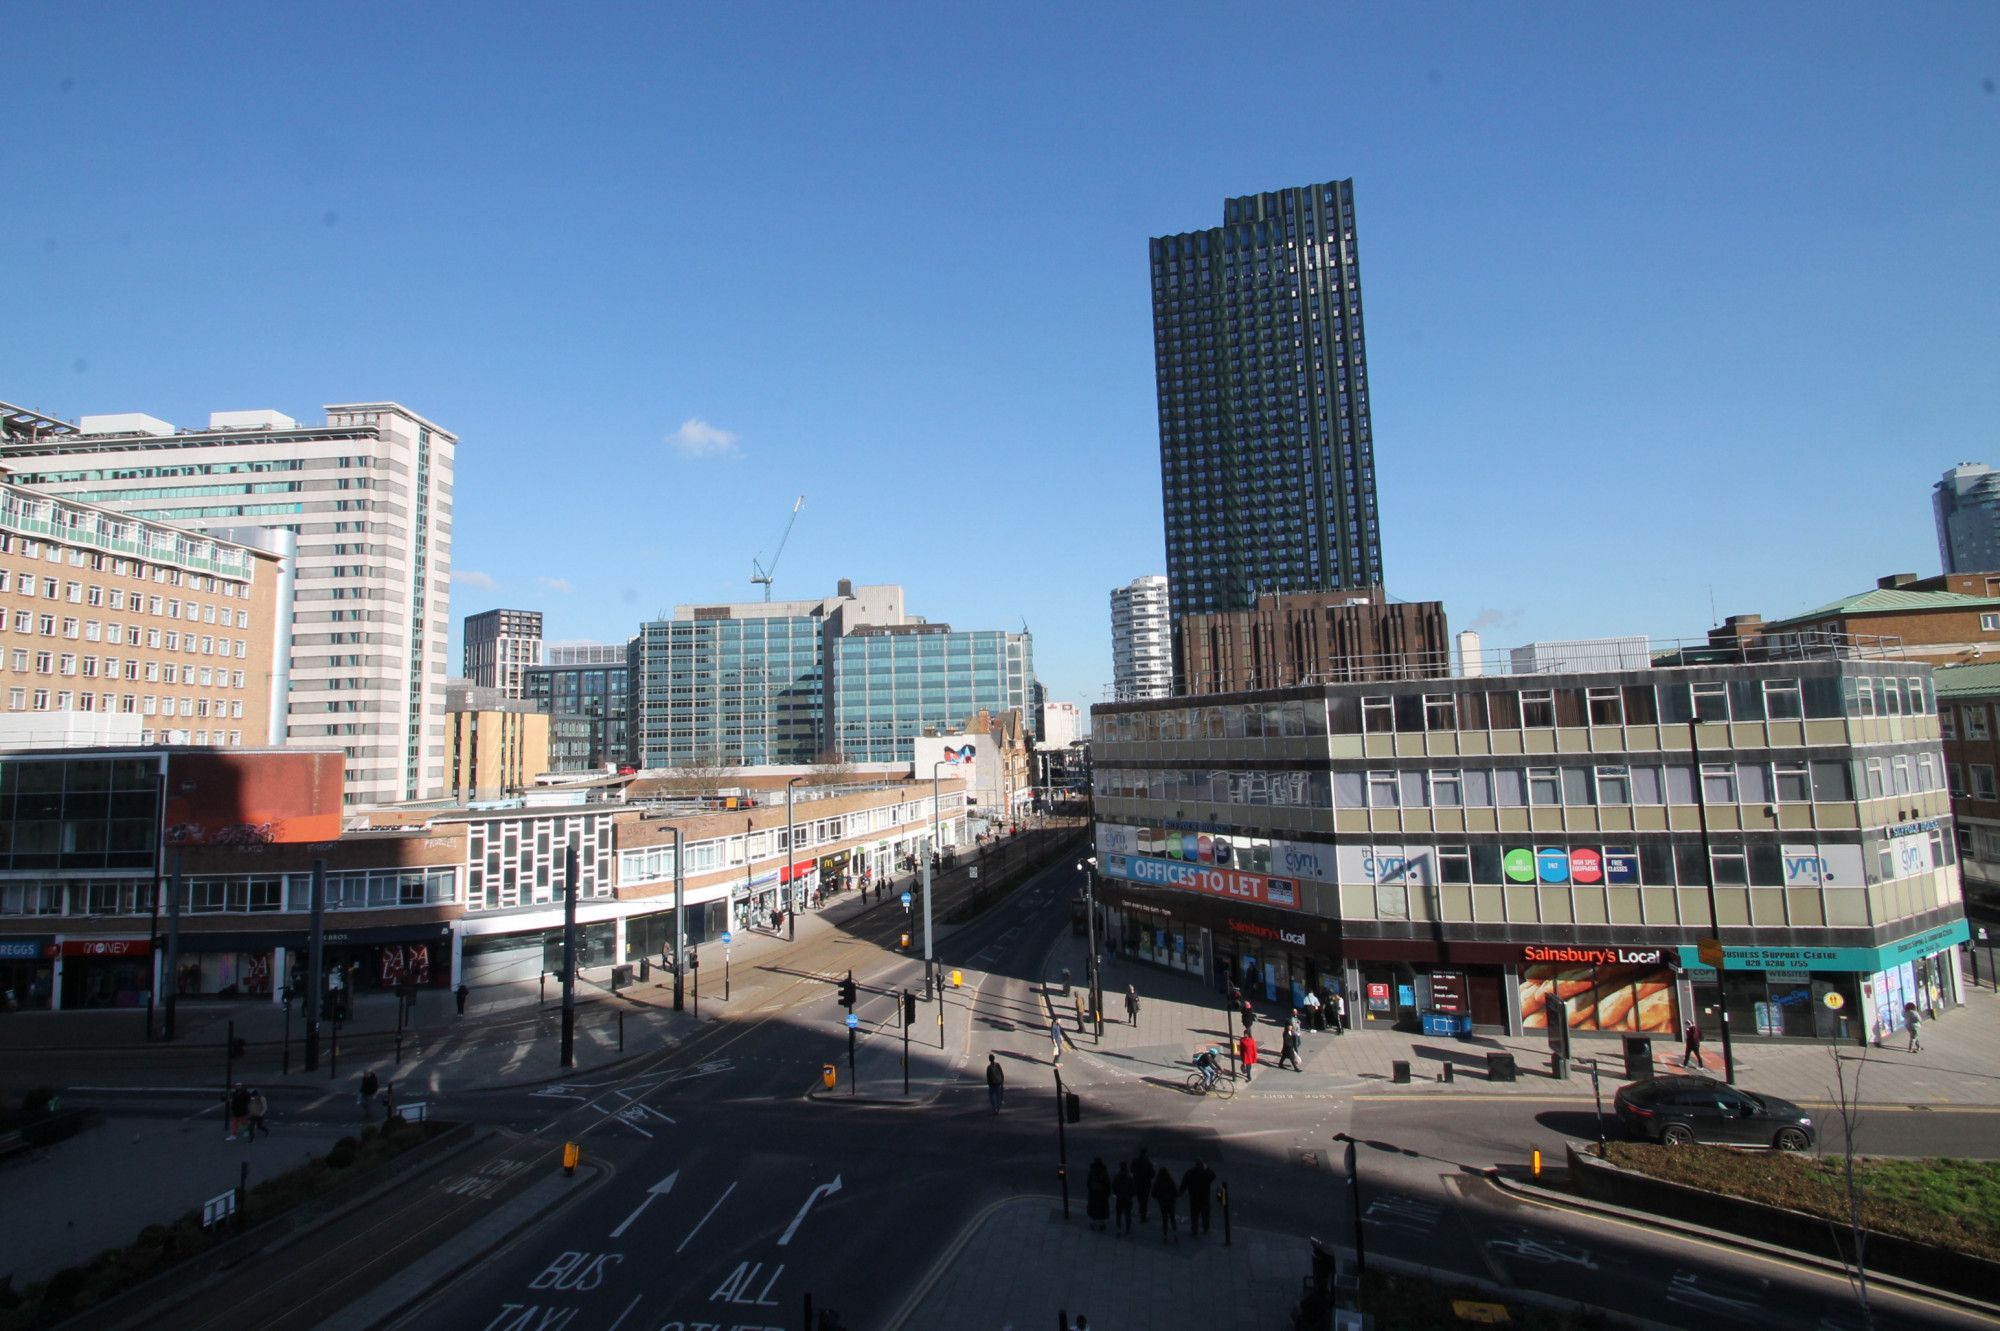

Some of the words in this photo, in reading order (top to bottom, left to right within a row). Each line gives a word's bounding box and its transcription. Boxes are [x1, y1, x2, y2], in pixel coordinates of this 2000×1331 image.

[1135, 860, 1196, 886] OFFICES
[1196, 871, 1225, 892] TO
[1228, 875, 1262, 898] LET
[1280, 929, 1306, 946] Local
[1524, 947, 1616, 966] Sainsbury's
[1618, 949, 1660, 963] Local
[528, 1251, 624, 1291] BUS
[709, 1261, 786, 1306] ALL
